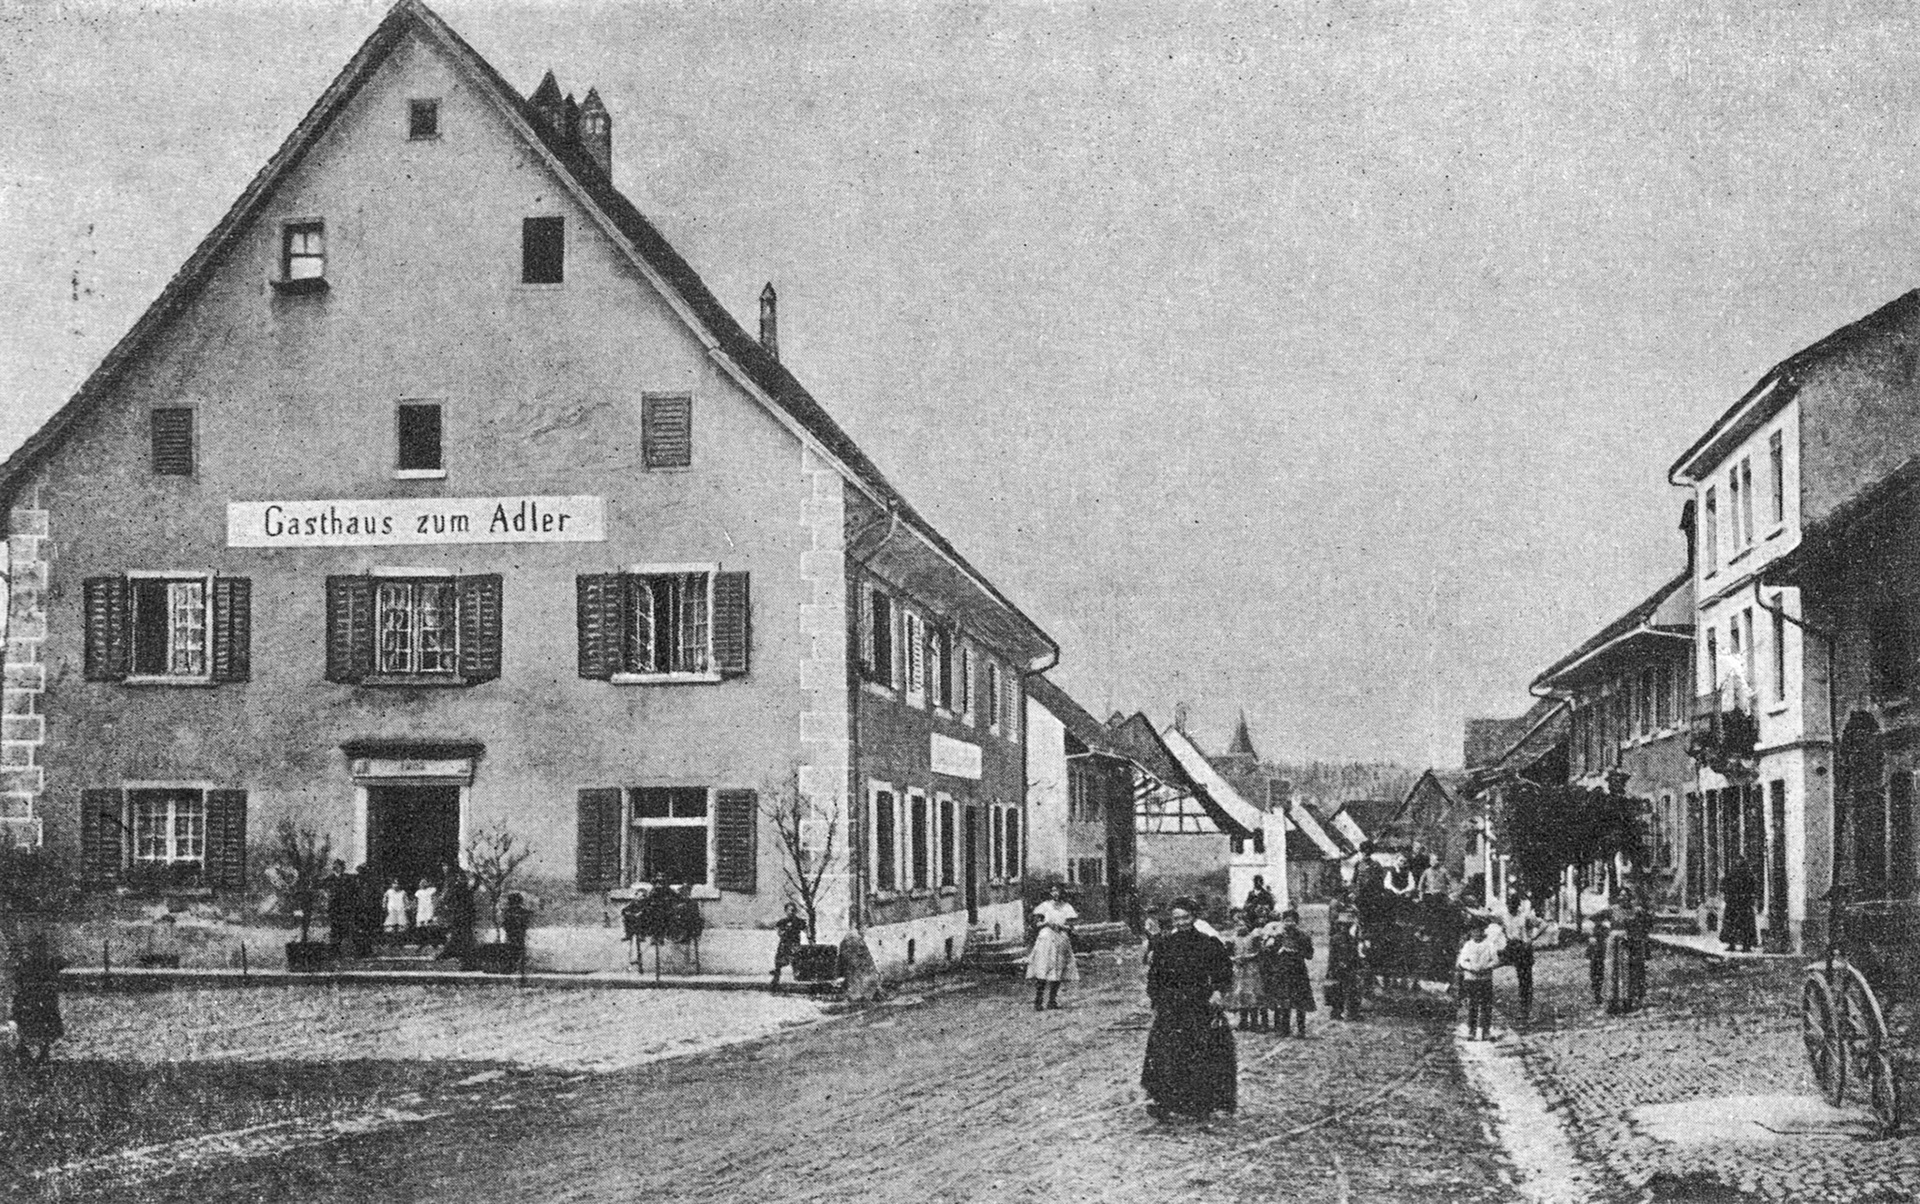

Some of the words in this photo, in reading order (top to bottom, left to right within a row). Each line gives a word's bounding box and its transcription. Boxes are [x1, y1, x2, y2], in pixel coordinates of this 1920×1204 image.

[264, 505, 393, 537] Gasthaus
[416, 514, 470, 535] zum
[489, 500, 572, 533] Adler
